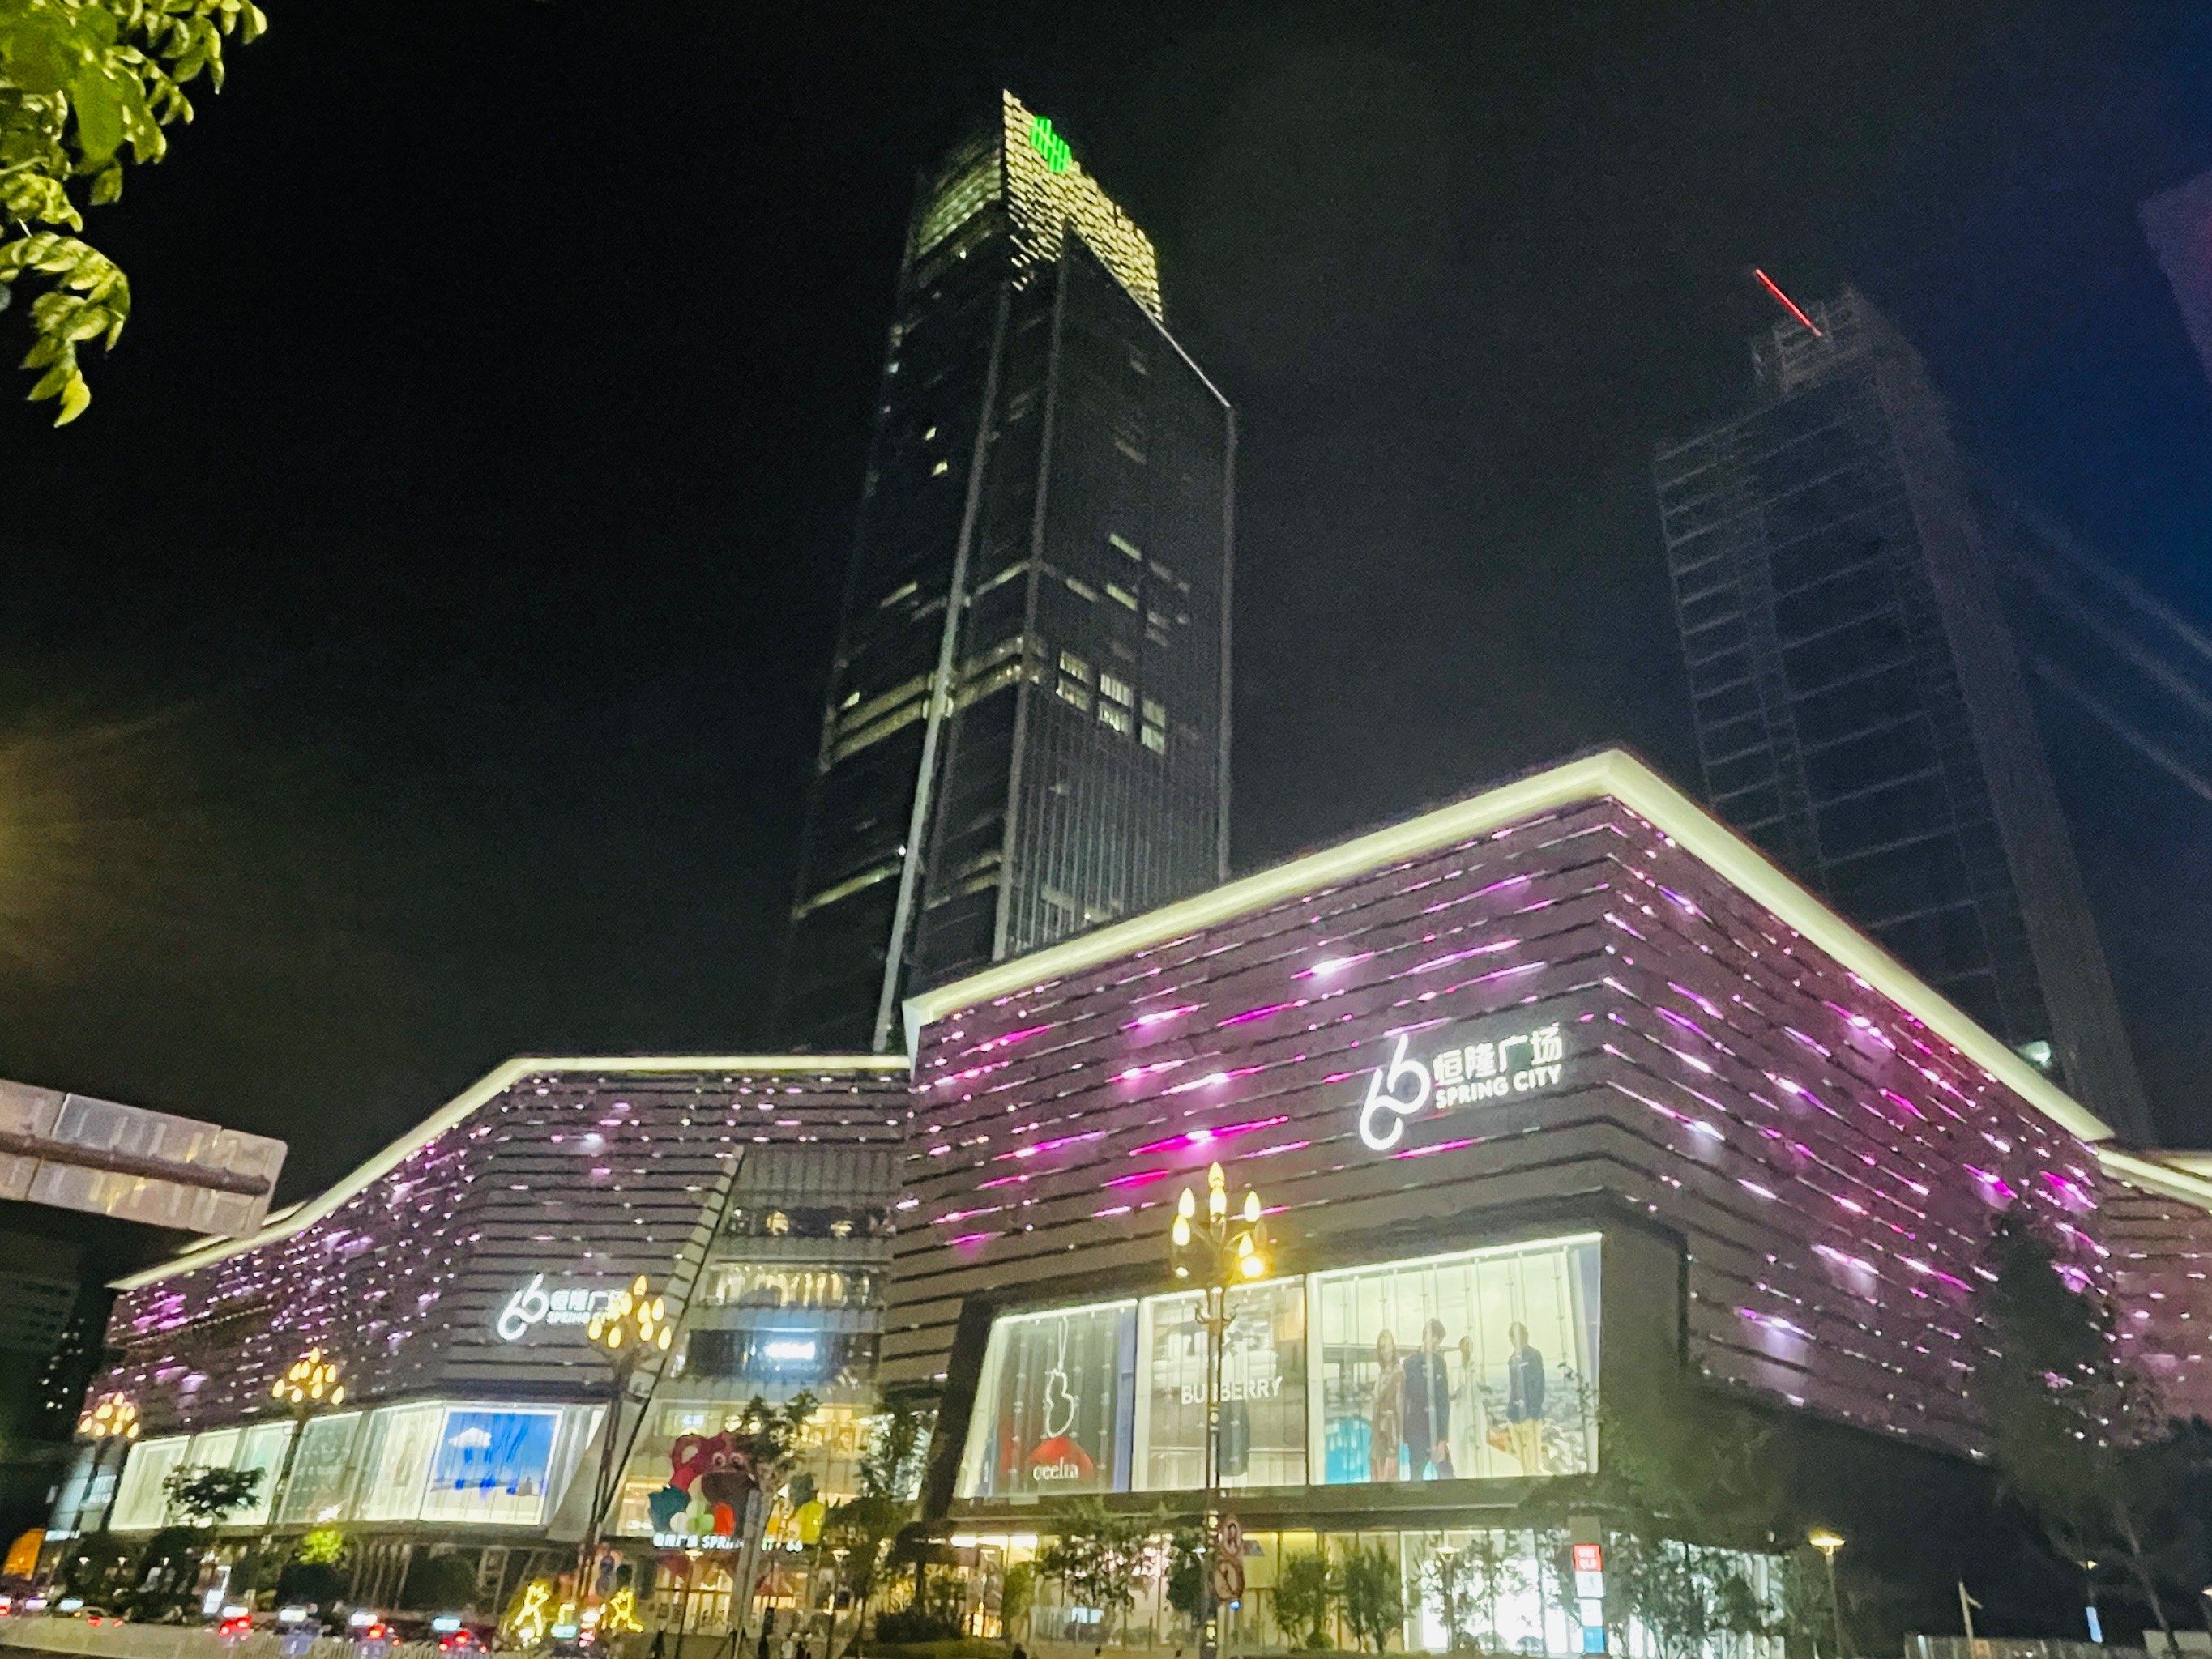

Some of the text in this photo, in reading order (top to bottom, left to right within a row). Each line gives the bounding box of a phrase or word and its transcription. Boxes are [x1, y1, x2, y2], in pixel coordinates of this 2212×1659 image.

[1433, 1023, 1562, 1085] 恒隆广场
[1435, 1064, 1561, 1109] SPRING CITY
[1181, 1376, 1283, 1405] BUBERRY
